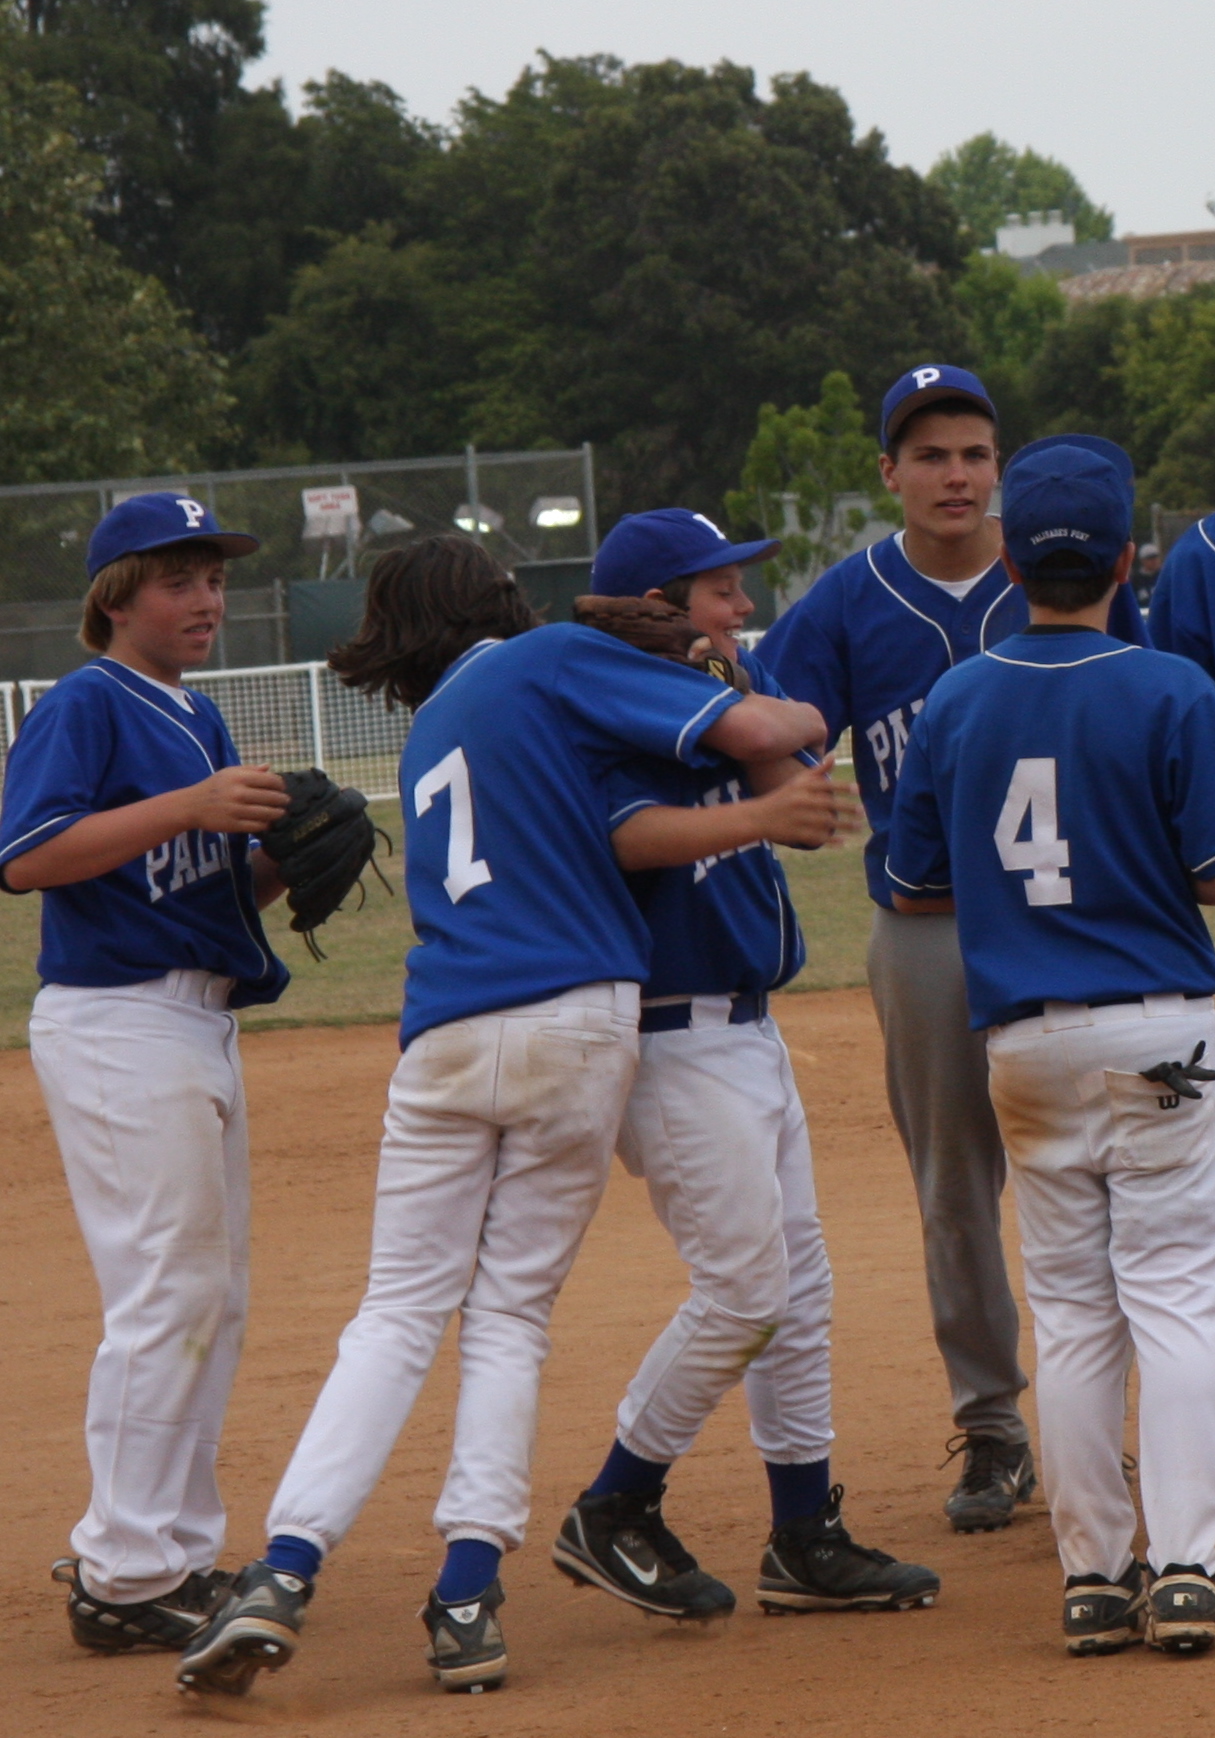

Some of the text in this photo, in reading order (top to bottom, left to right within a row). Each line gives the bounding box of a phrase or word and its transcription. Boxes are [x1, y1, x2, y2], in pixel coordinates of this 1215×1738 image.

[911, 367, 941, 389] P
[175, 499, 205, 528] P
[414, 746, 493, 905] 7
[993, 757, 1073, 907] 4
